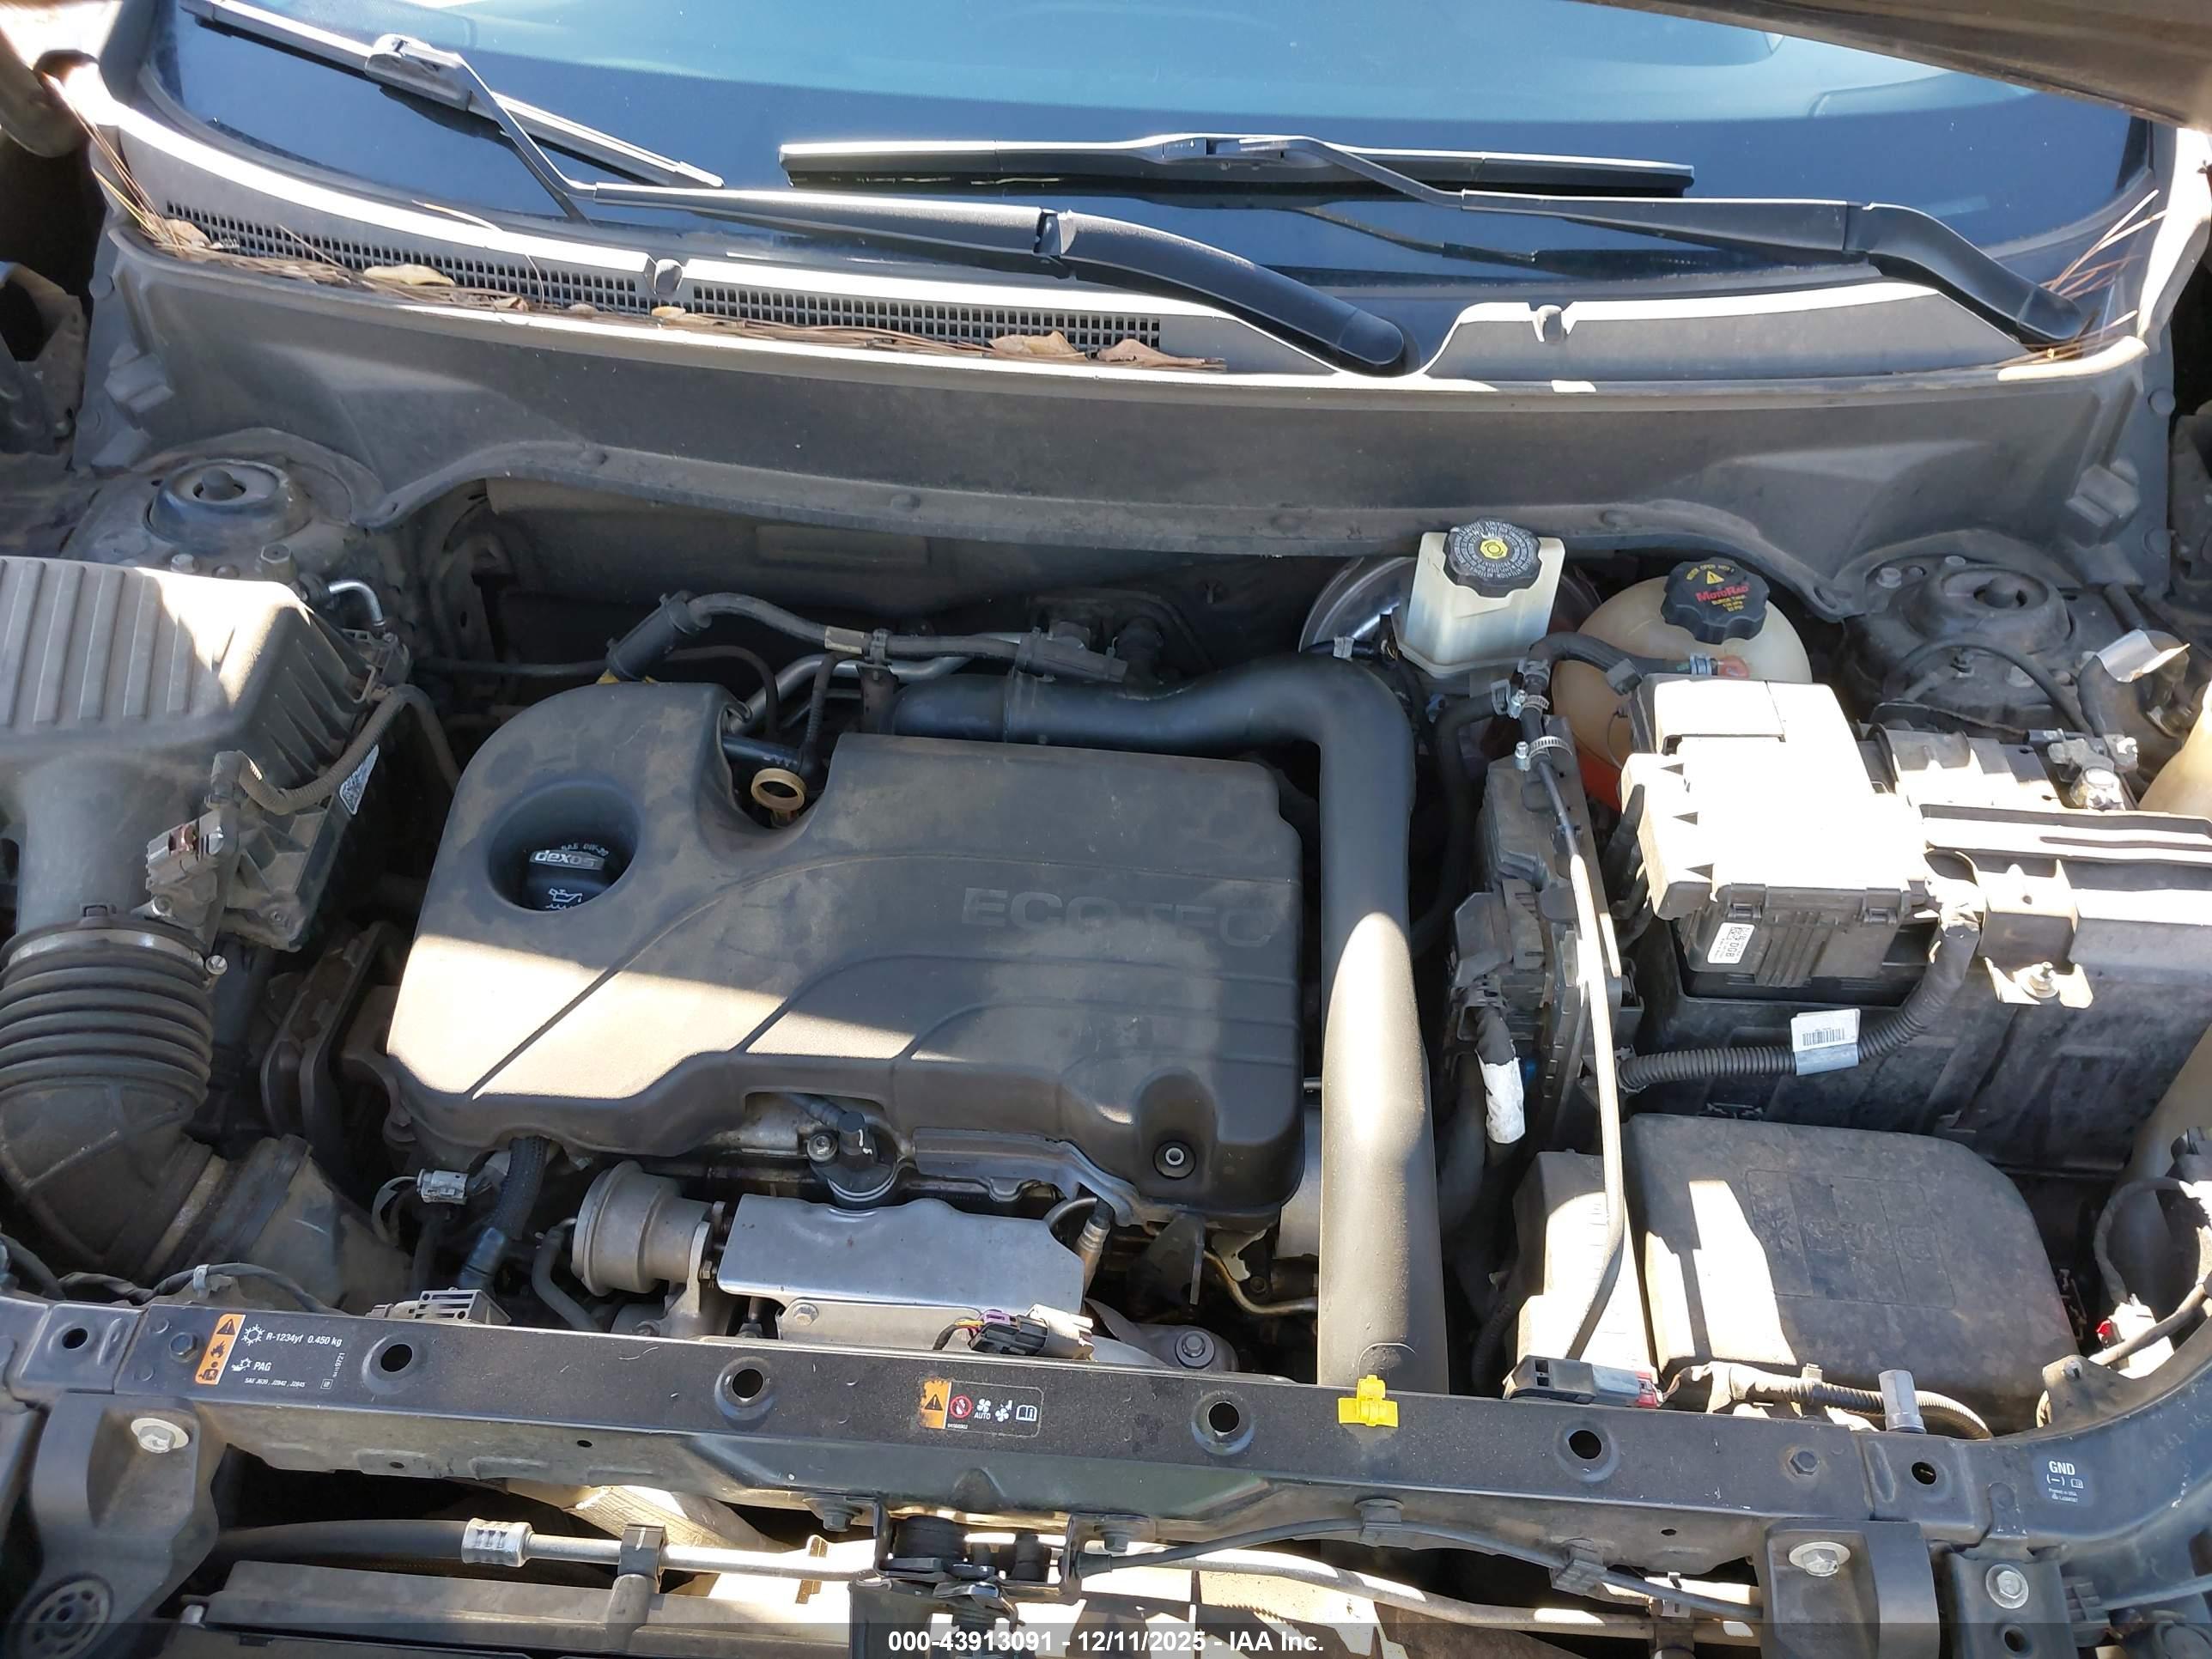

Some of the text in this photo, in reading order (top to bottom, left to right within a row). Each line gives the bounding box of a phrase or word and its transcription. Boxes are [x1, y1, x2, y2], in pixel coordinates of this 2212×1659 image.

[535, 849, 599, 867] dexos
[265, 1332, 343, 1347] R-1234yf 0.450 kg
[252, 1361, 272, 1371] PAG
[2049, 1461, 2075, 1475] GND
